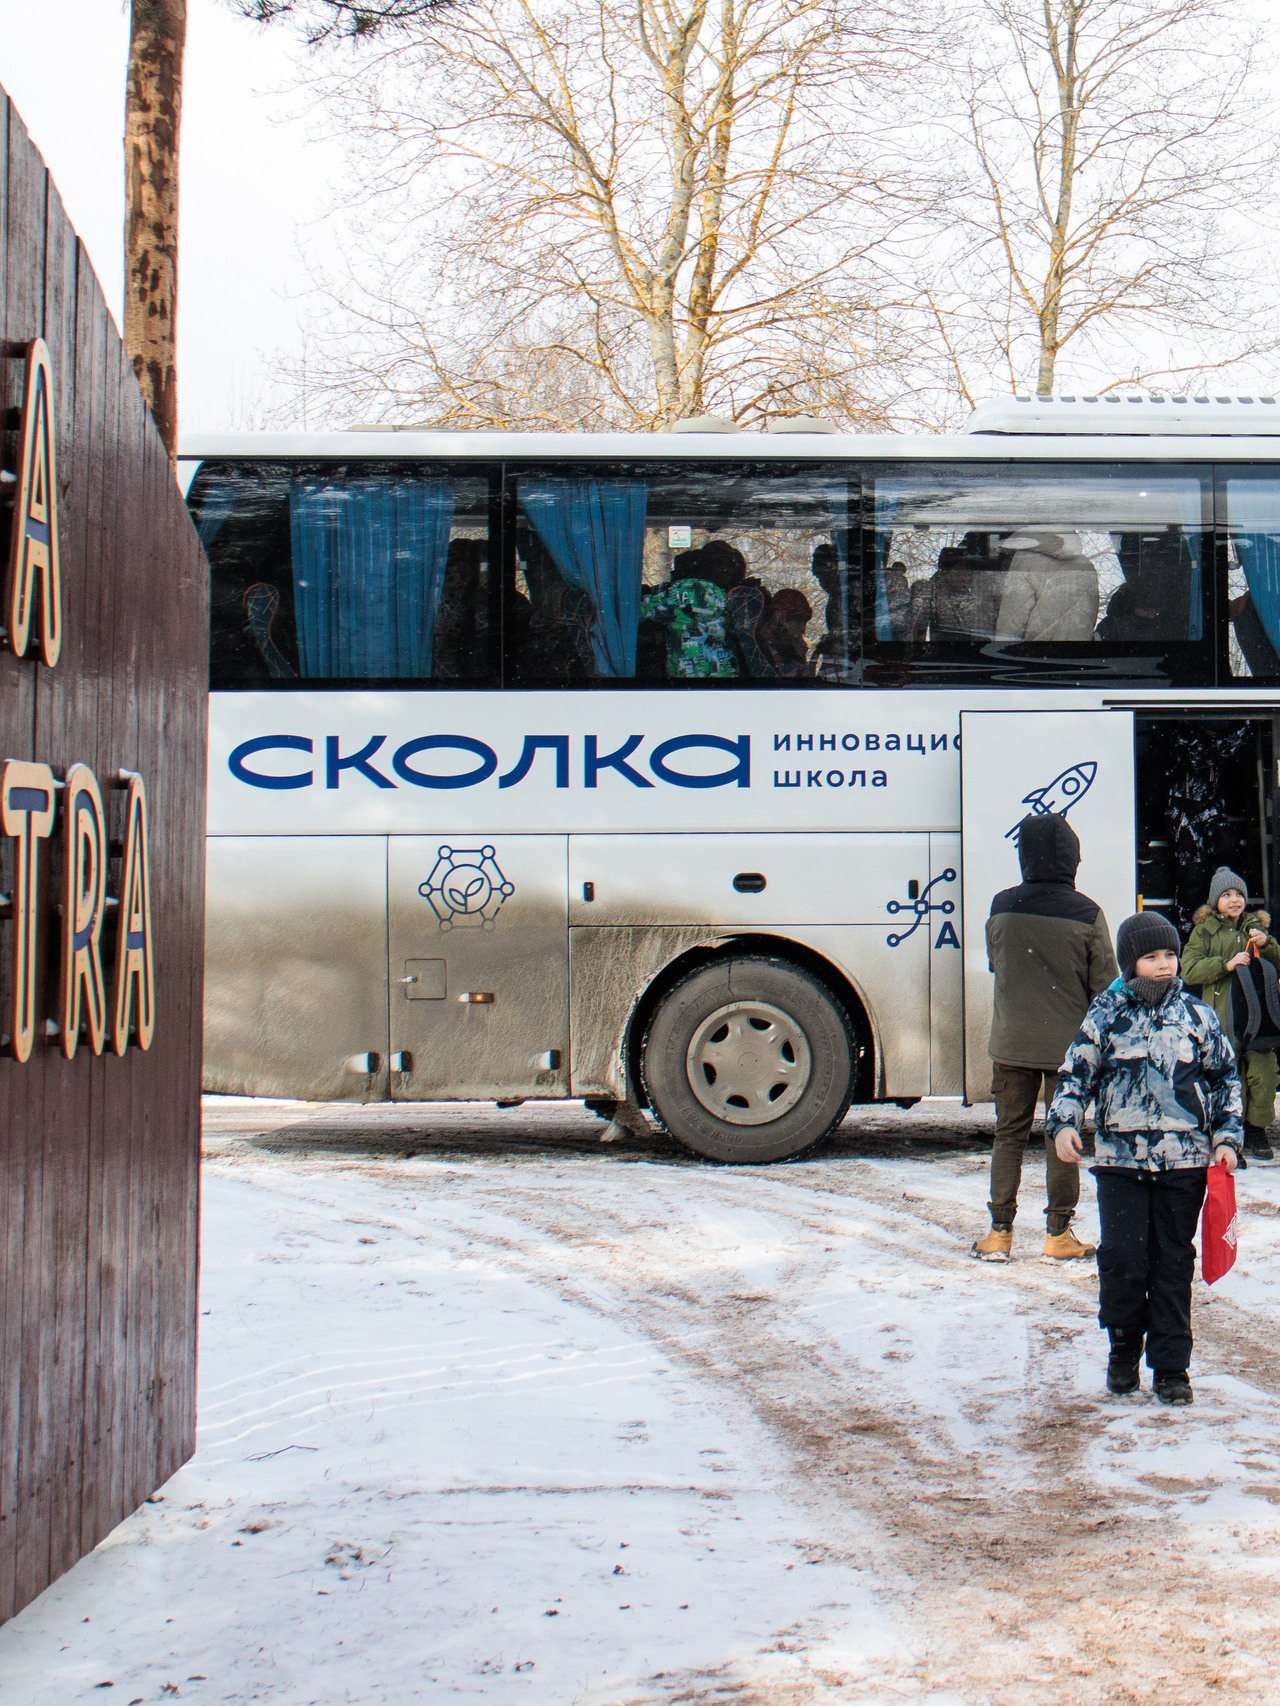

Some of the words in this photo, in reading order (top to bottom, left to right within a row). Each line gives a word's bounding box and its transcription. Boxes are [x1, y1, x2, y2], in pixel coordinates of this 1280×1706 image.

[12, 338, 61, 667] A
[2, 760, 155, 1064] TRA
[773, 769, 888, 788] школа
